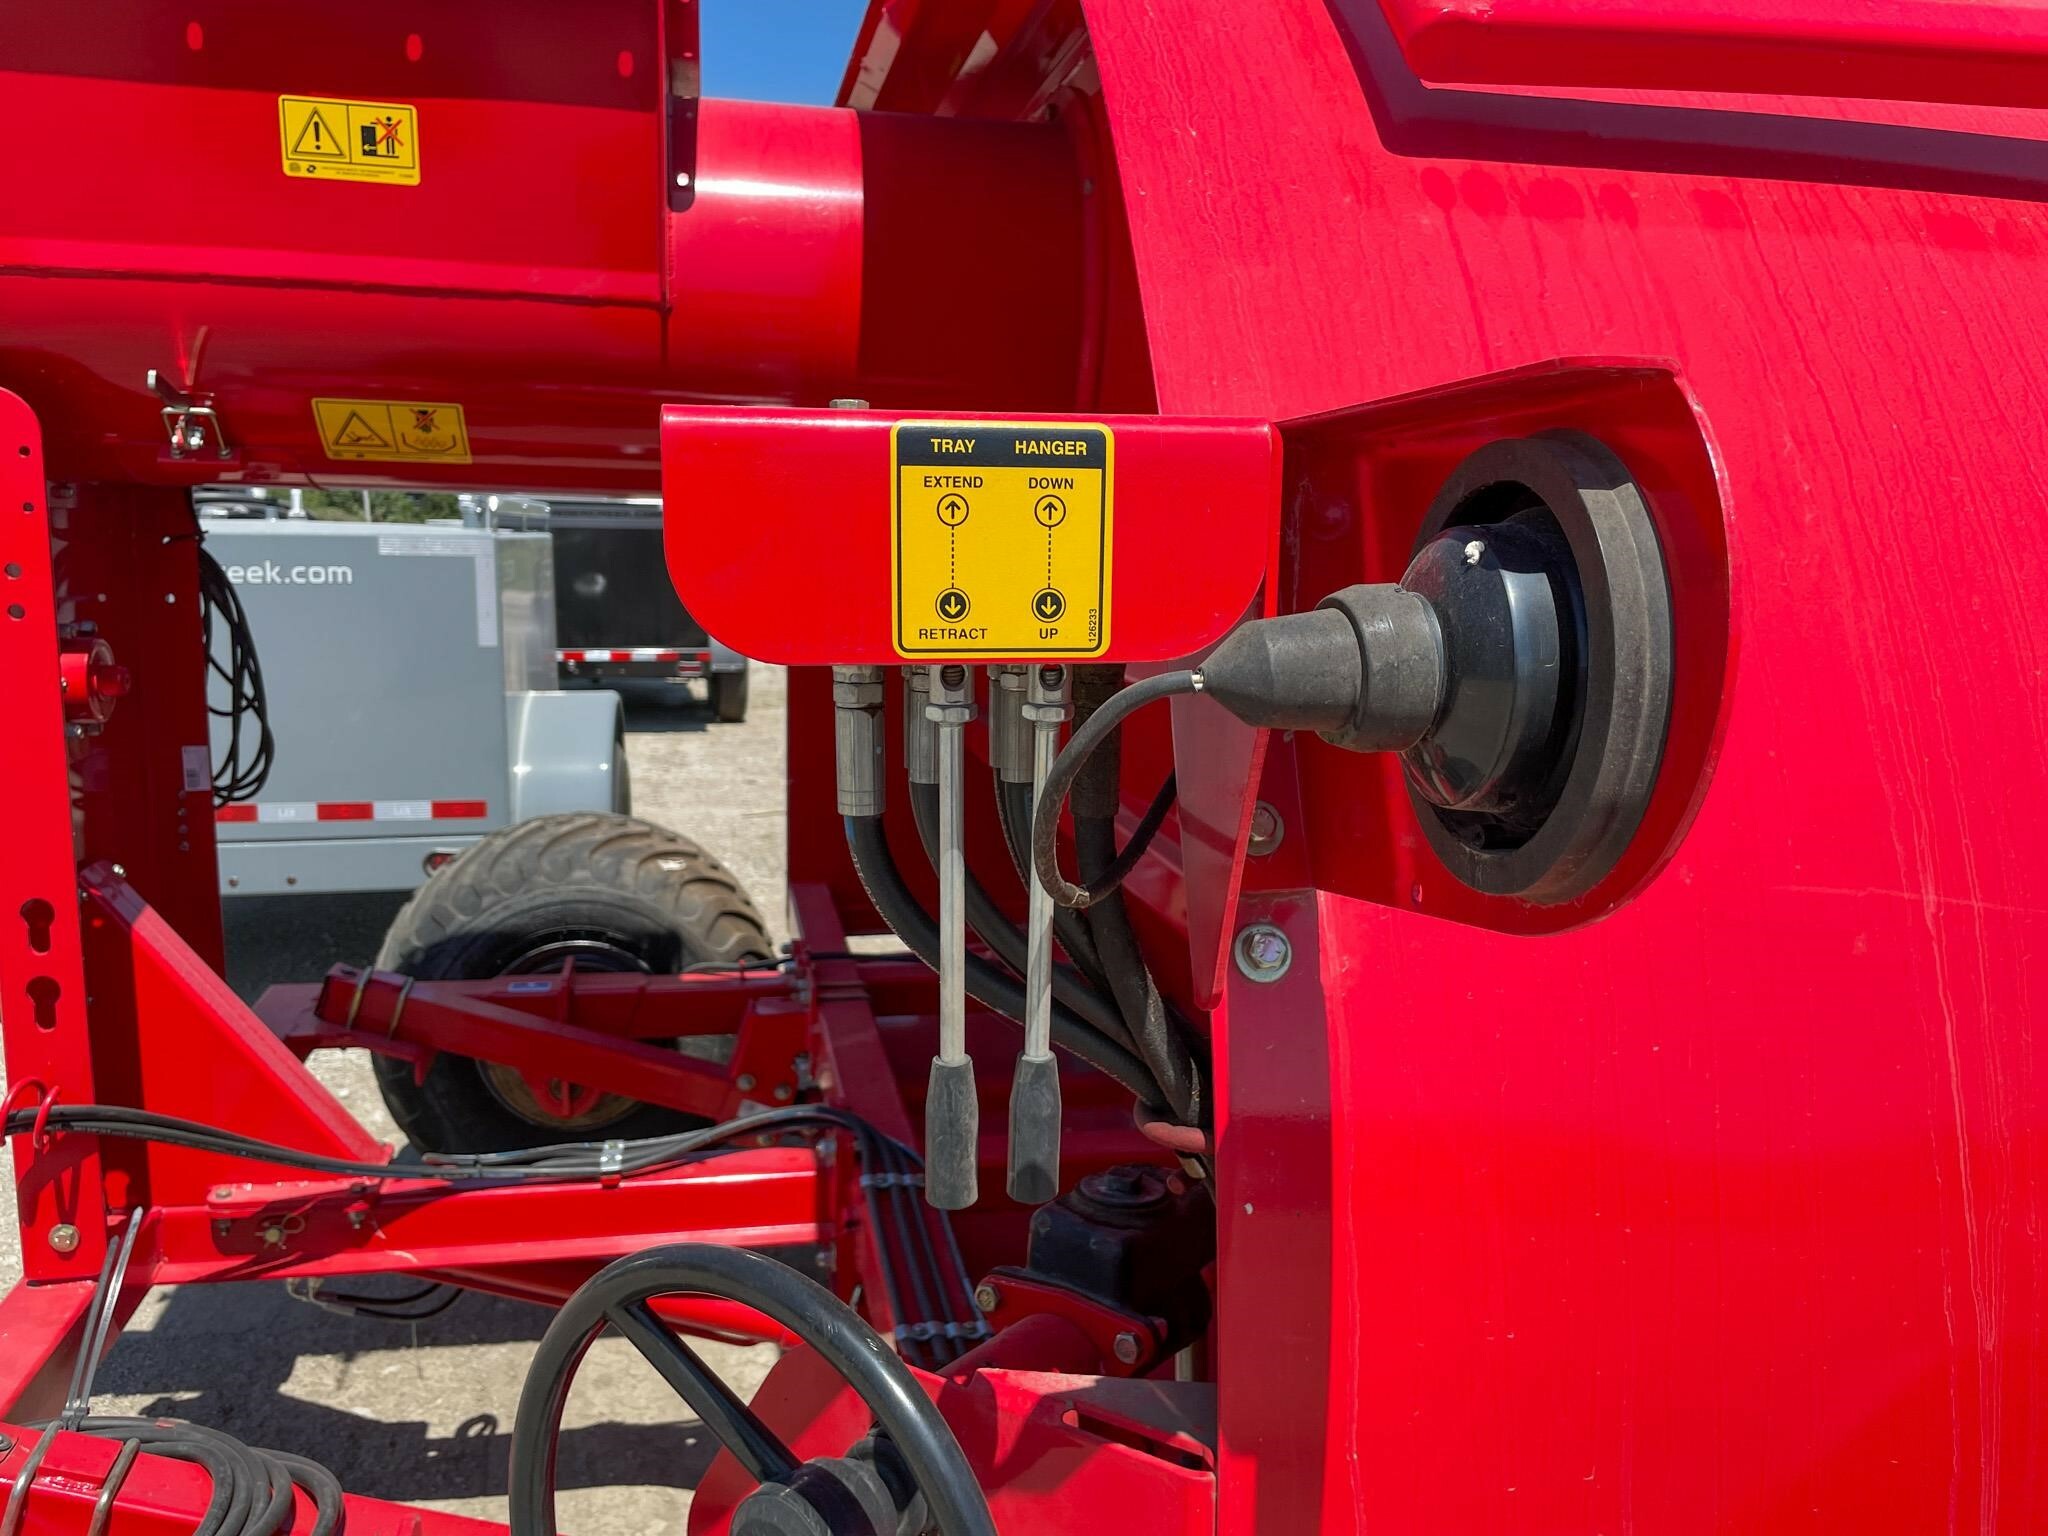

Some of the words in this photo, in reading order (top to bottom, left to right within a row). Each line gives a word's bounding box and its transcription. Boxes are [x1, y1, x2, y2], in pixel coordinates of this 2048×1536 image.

[930, 438, 976, 454] TRAY
[1015, 440, 1088, 456] HANGER
[923, 476, 984, 488] EXTEND
[1028, 478, 1074, 490] DOWN
[1088, 608, 1097, 643] 126233
[919, 628, 988, 640] RETRACT
[1039, 628, 1059, 640] UP
